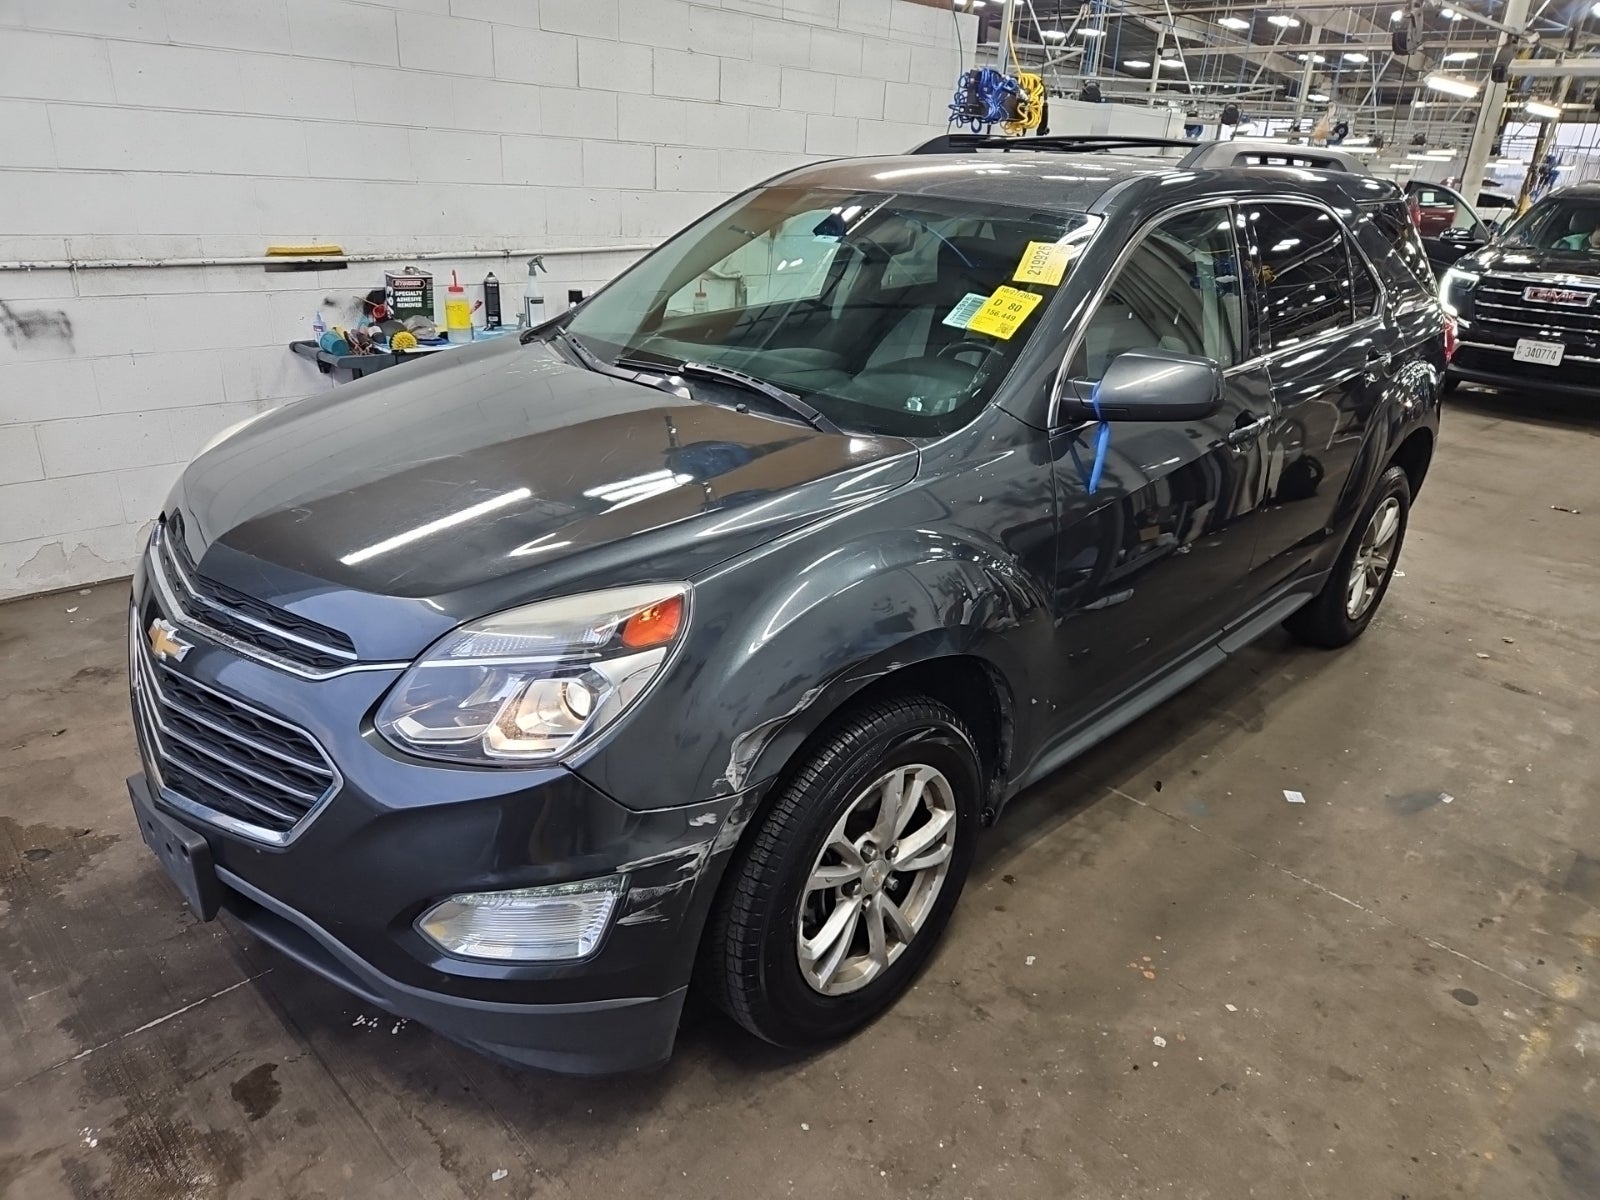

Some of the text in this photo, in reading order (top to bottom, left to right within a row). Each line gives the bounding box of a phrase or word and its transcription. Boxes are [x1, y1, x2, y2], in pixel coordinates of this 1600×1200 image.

[993, 298, 1003, 307] D
[1007, 302, 1022, 313] 80
[1524, 347, 1557, 360] 340774
